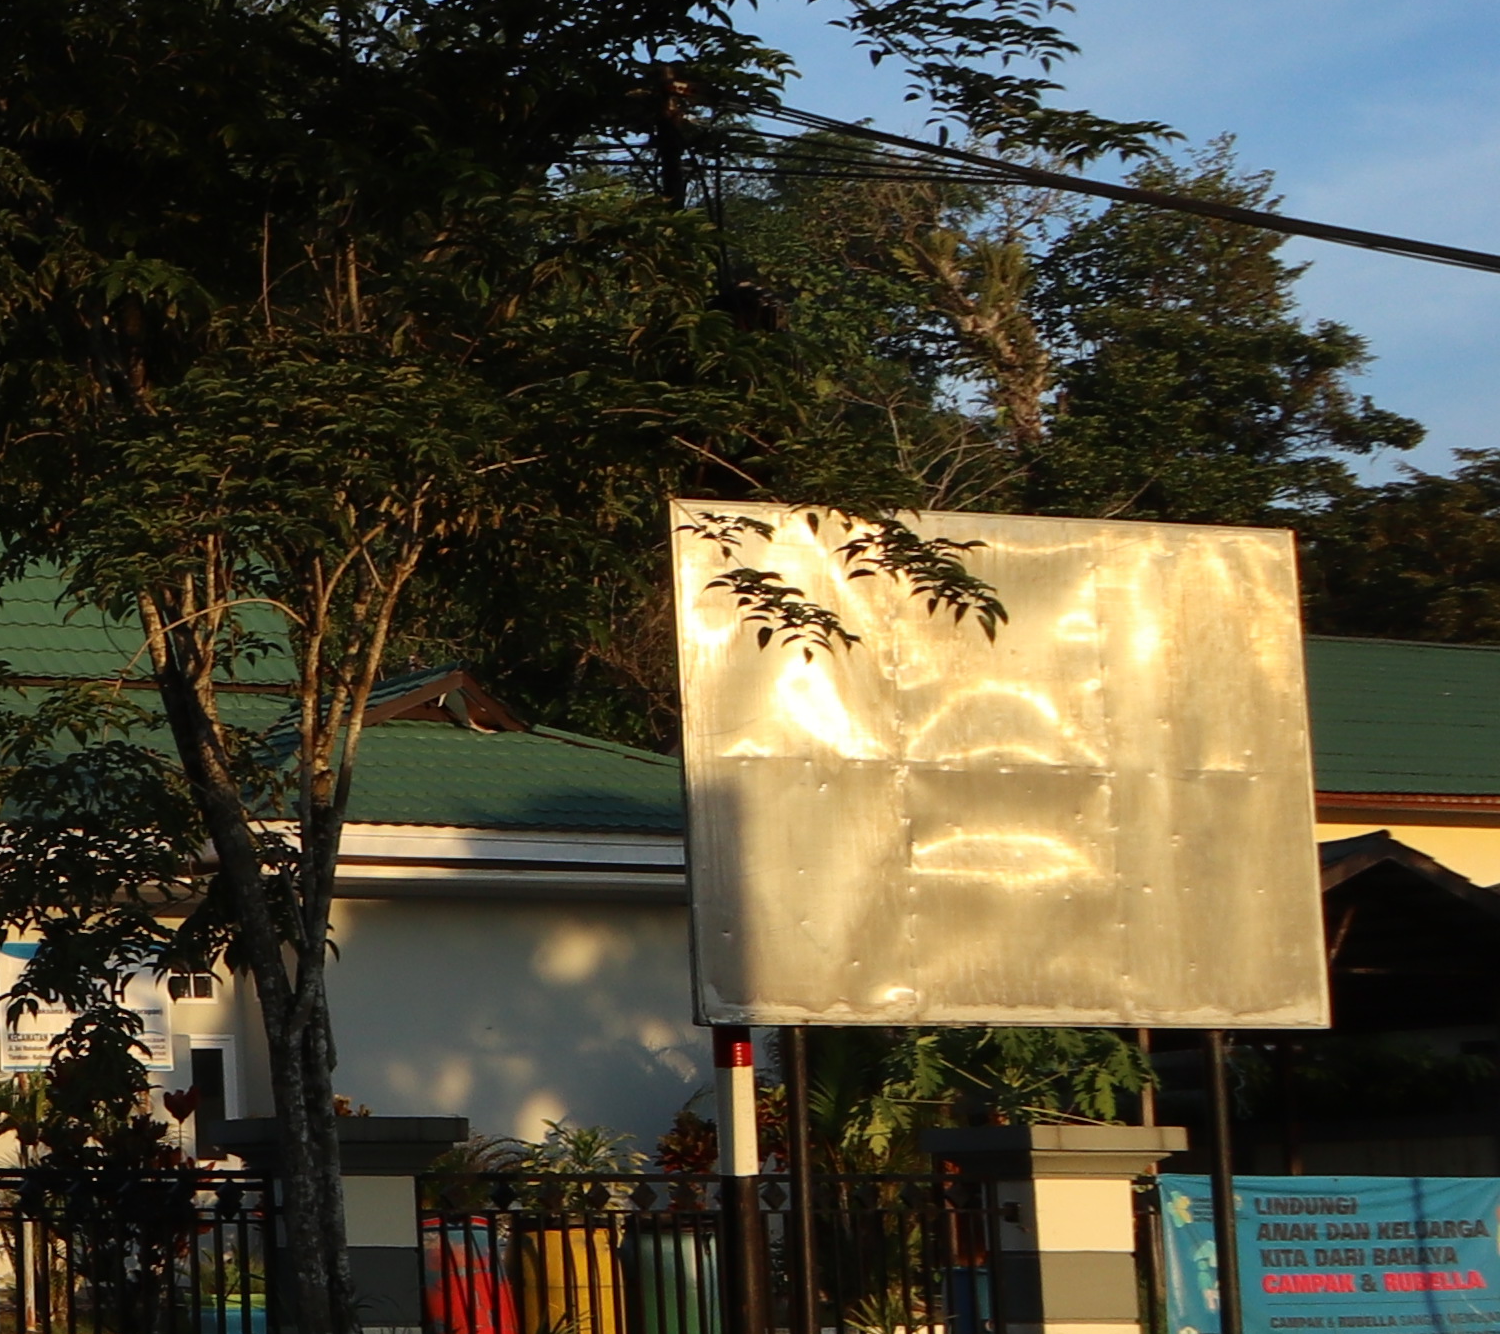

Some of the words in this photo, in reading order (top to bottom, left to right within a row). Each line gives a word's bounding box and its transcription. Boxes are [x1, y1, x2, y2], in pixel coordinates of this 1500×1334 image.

[1255, 1196, 1358, 1216] LINDUNGI
[1258, 1222, 1318, 1241] ANAK
[1326, 1222, 1370, 1241] DAN
[1377, 1219, 1490, 1240] KELUARGA
[1259, 1248, 1309, 1267] KITA
[1314, 1248, 1366, 1267] DARI
[1373, 1246, 1458, 1266] BAHAYA
[1261, 1273, 1357, 1293] CAMPAK
[1360, 1273, 1378, 1293] &
[1383, 1270, 1488, 1291] RUBELLA
[1270, 1316, 1325, 1328] CAMPAK
[1339, 1315, 1397, 1327] RUBELLA
